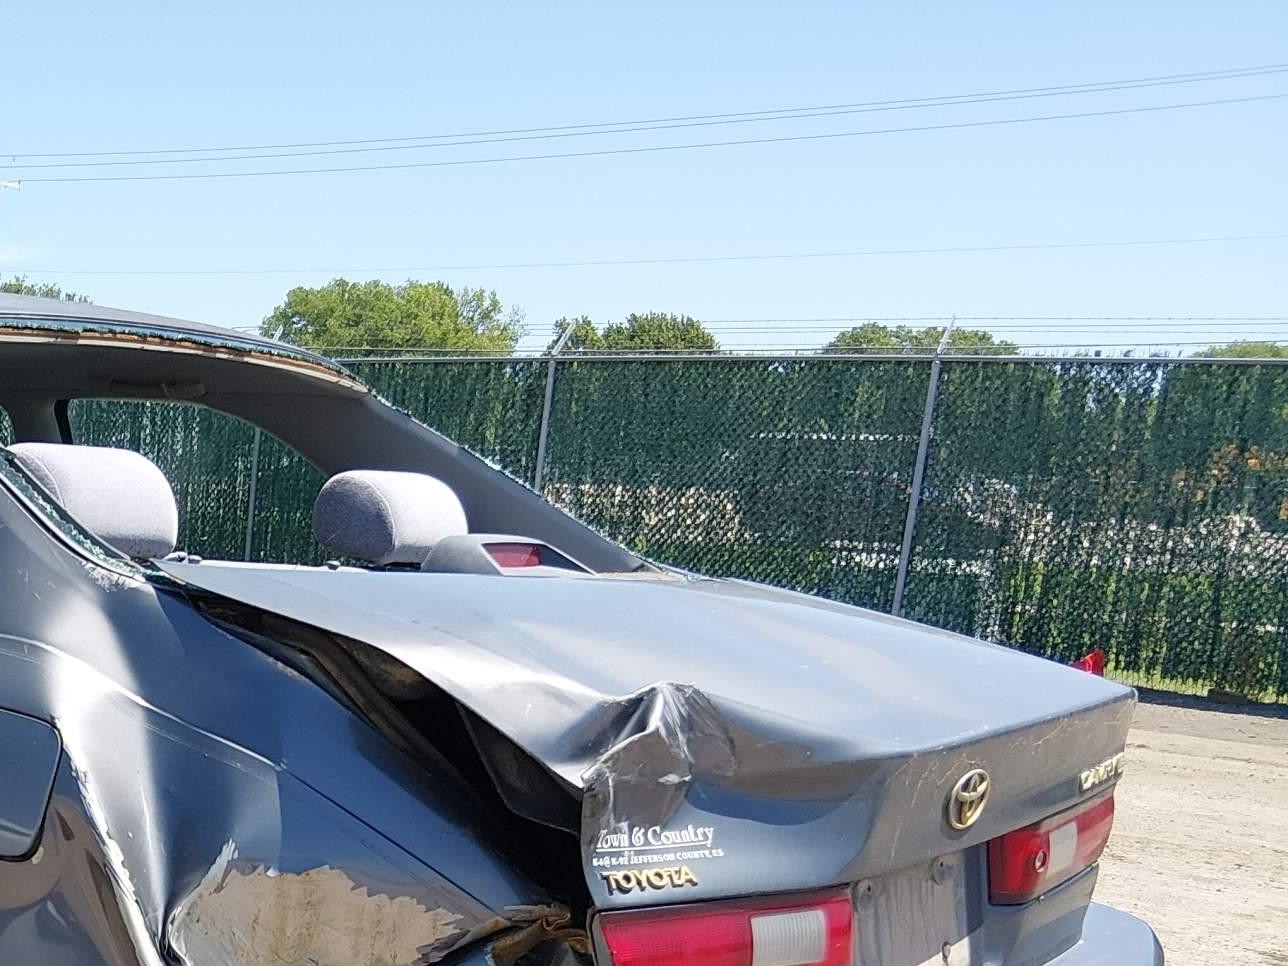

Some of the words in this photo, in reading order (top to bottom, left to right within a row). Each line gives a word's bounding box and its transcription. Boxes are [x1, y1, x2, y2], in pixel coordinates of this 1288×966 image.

[631, 826, 648, 847] &
[648, 825, 714, 847] Country
[600, 865, 697, 894] TOYOTA
